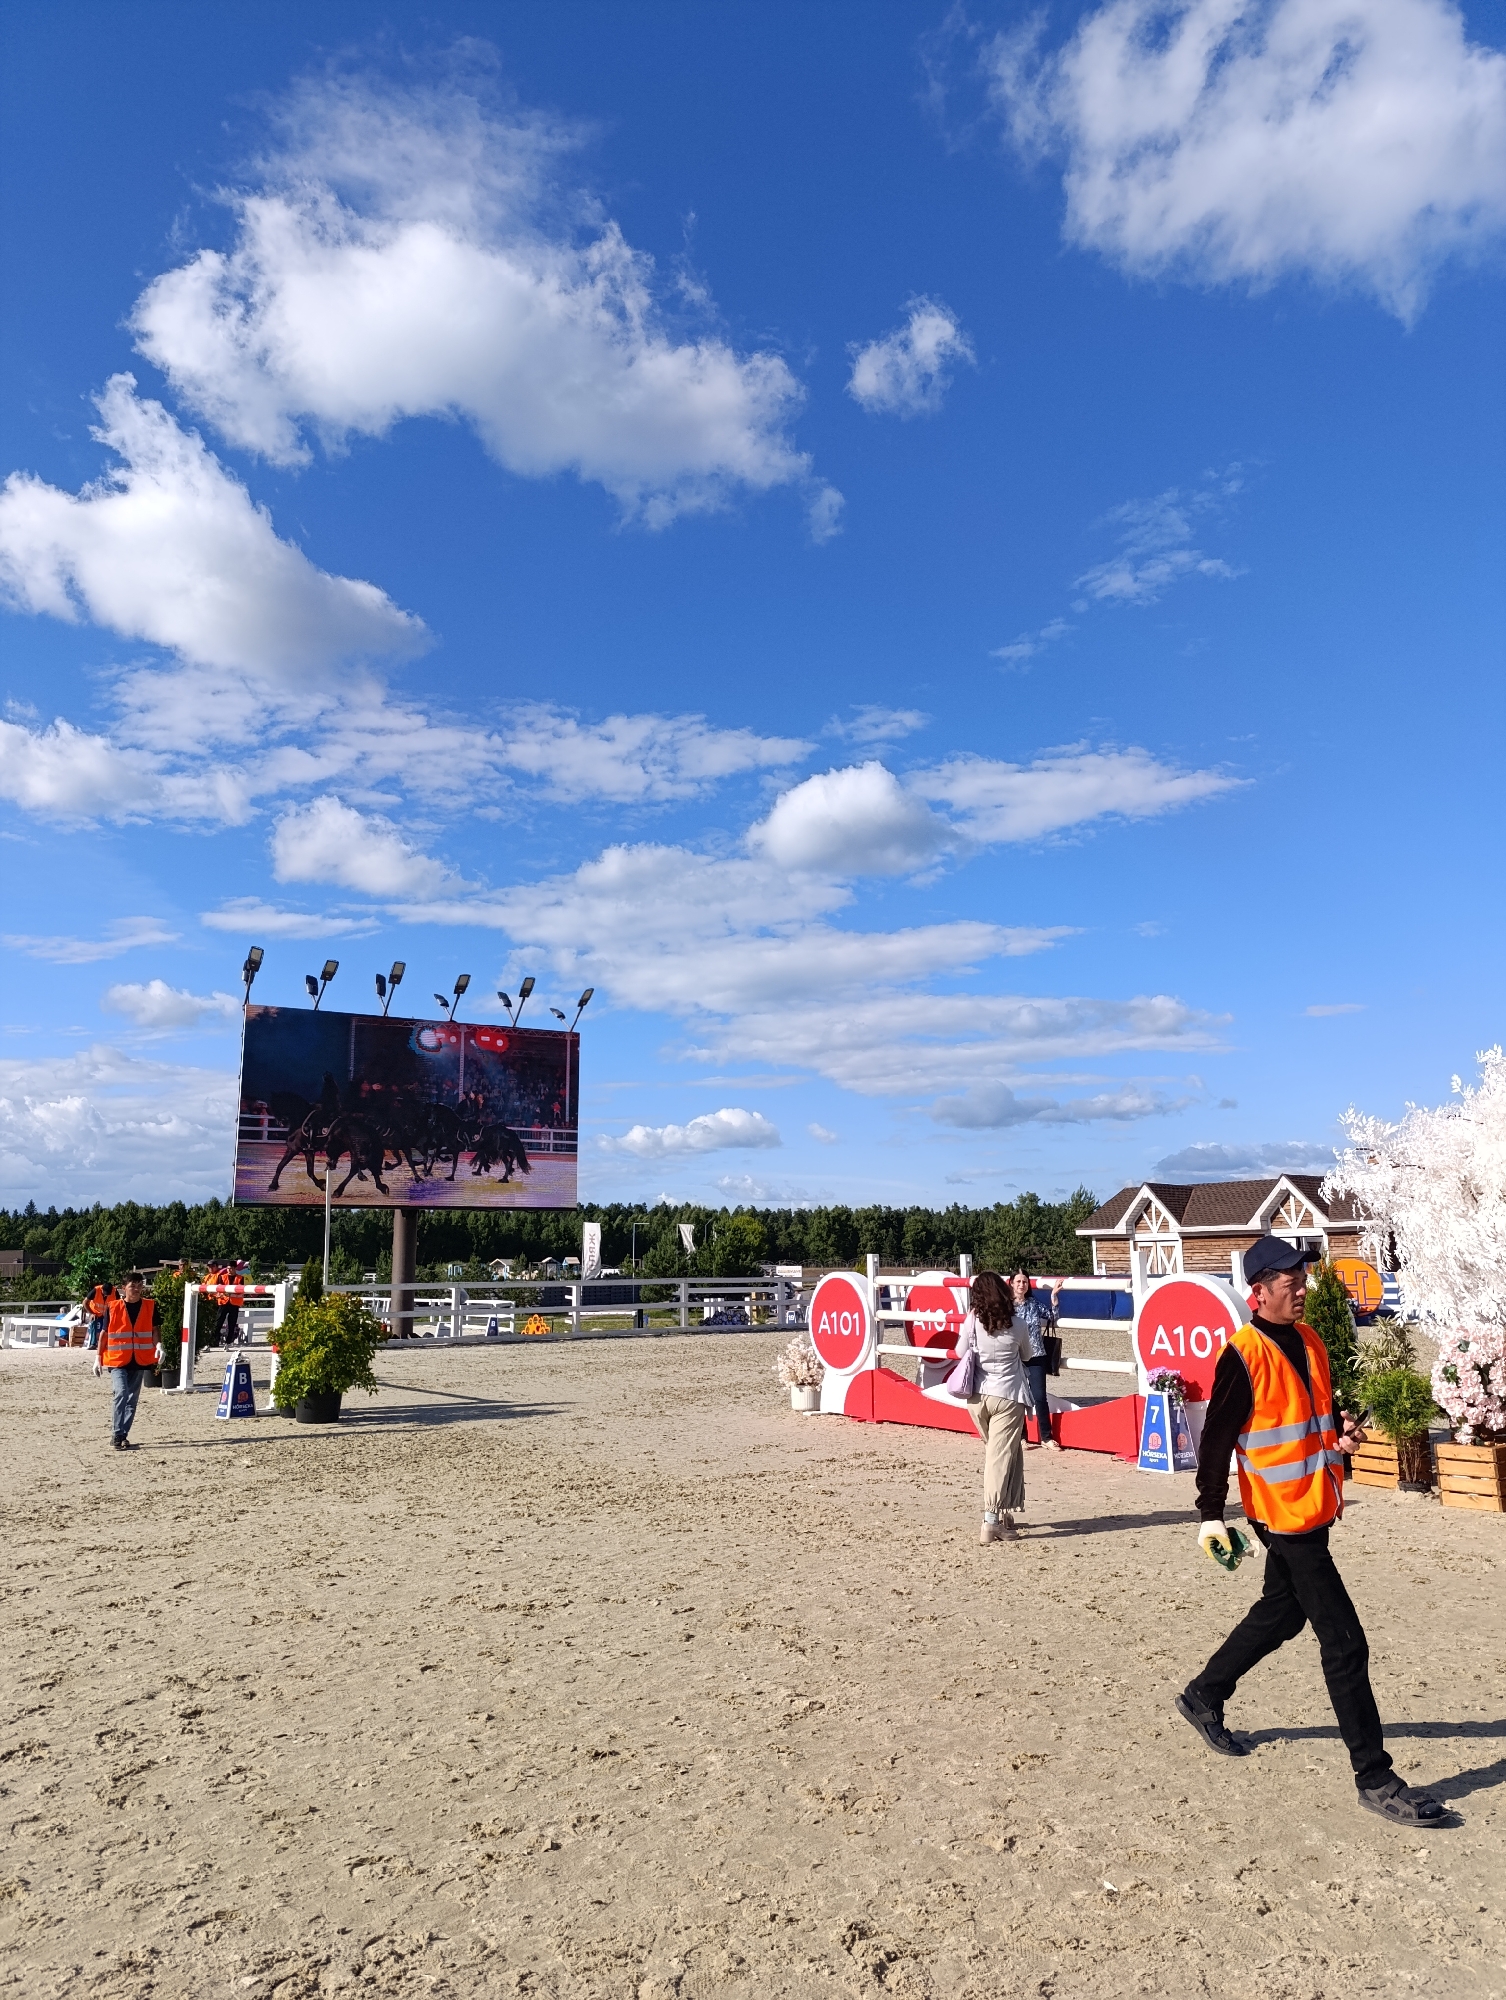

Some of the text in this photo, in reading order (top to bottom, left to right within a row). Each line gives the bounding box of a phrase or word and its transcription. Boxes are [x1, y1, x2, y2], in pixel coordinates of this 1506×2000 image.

[818, 1310, 860, 1336] A101
[239, 1372, 248, 1385] B
[1150, 1405, 1160, 1424] 7
